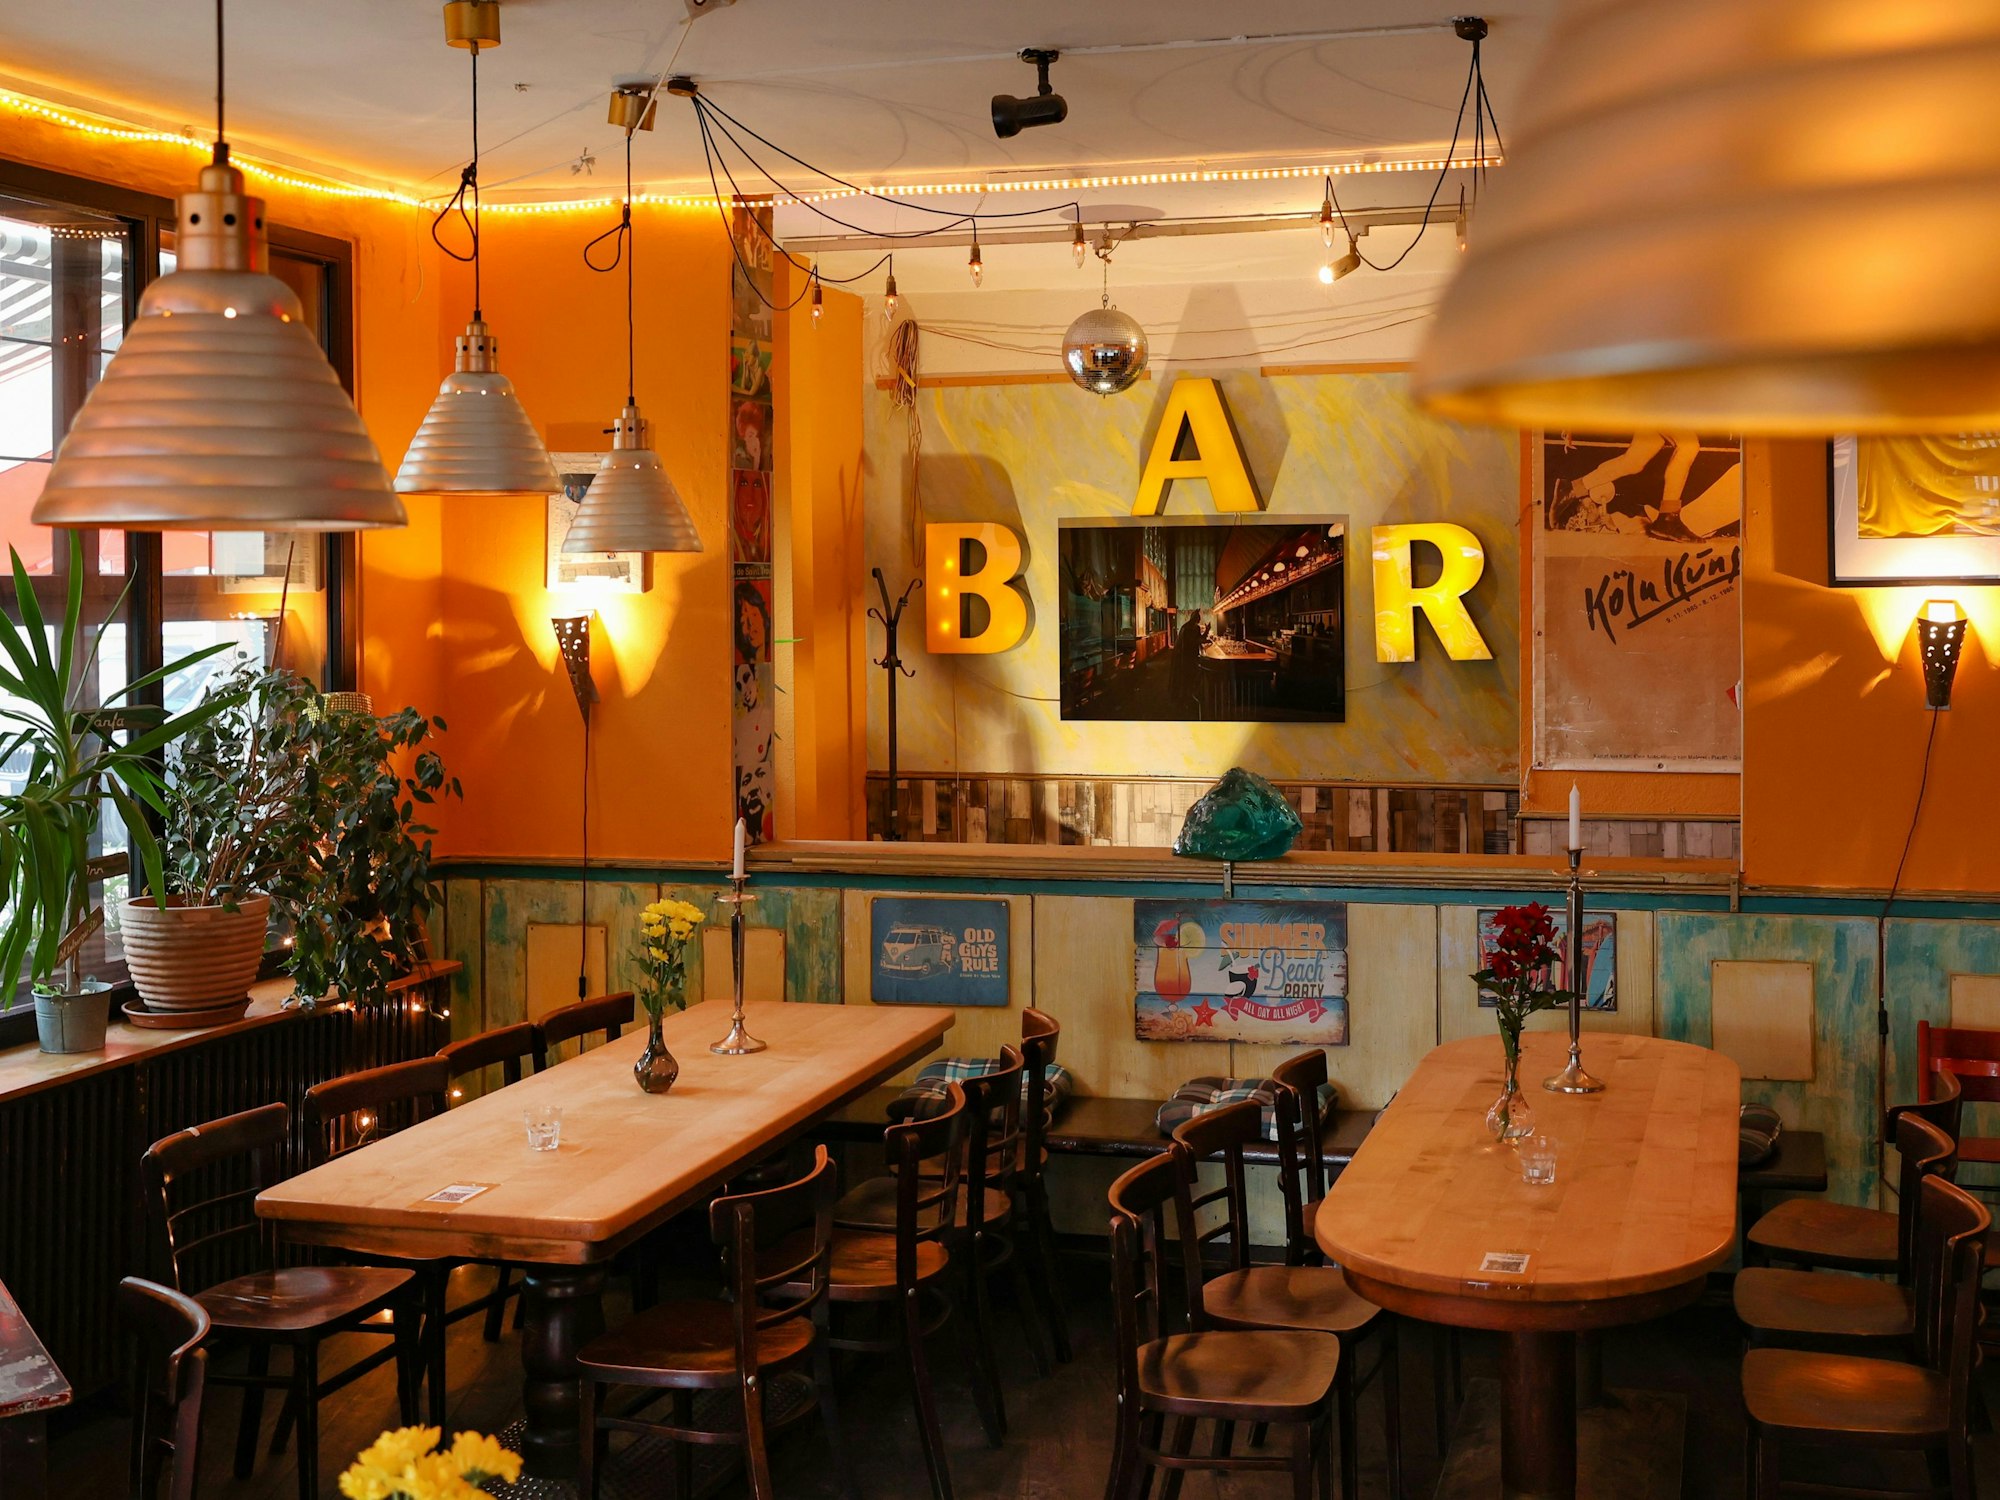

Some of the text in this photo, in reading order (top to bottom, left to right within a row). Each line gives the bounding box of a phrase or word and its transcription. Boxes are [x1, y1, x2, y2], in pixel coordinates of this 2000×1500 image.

[964, 928, 995, 943] OLD
[1219, 921, 1328, 960] SUMMER
[959, 942, 997, 958] GUYS
[961, 957, 998, 972] RULE
[1260, 945, 1324, 991] Beach
[1284, 983, 1324, 998] PARTY
[1243, 1001, 1305, 1019] ALL DAY ALL NIGHT
